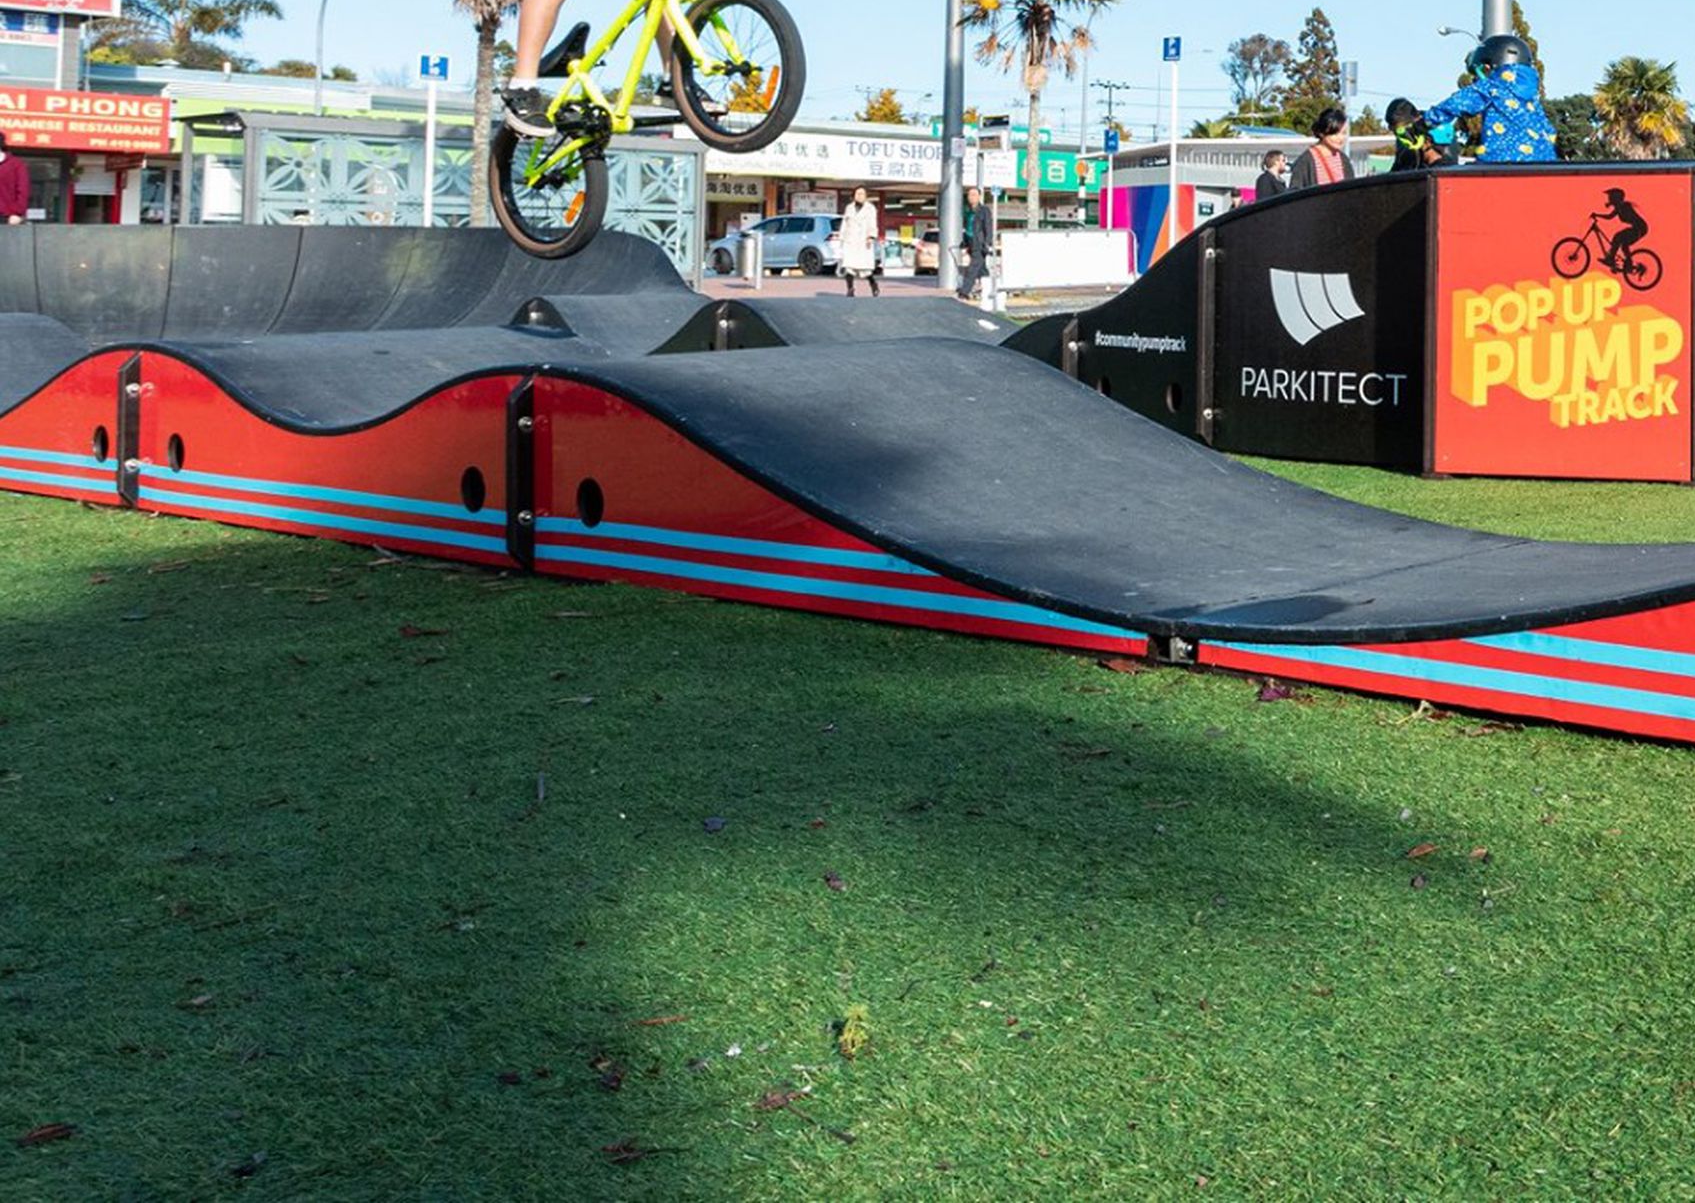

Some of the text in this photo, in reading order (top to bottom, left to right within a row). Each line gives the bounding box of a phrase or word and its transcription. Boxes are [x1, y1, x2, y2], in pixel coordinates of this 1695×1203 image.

[46, 96, 163, 117] PHONG
[68, 121, 161, 136] RESTAURANT
[846, 140, 895, 159] TOFU
[869, 160, 923, 179] 豆腐店
[1463, 279, 1622, 339] POP UP
[1094, 329, 1187, 354] #communitypumptrack
[1472, 318, 1684, 408] PUMP
[1241, 366, 1408, 406] PARKITECT
[1555, 379, 1679, 428] TRACK
